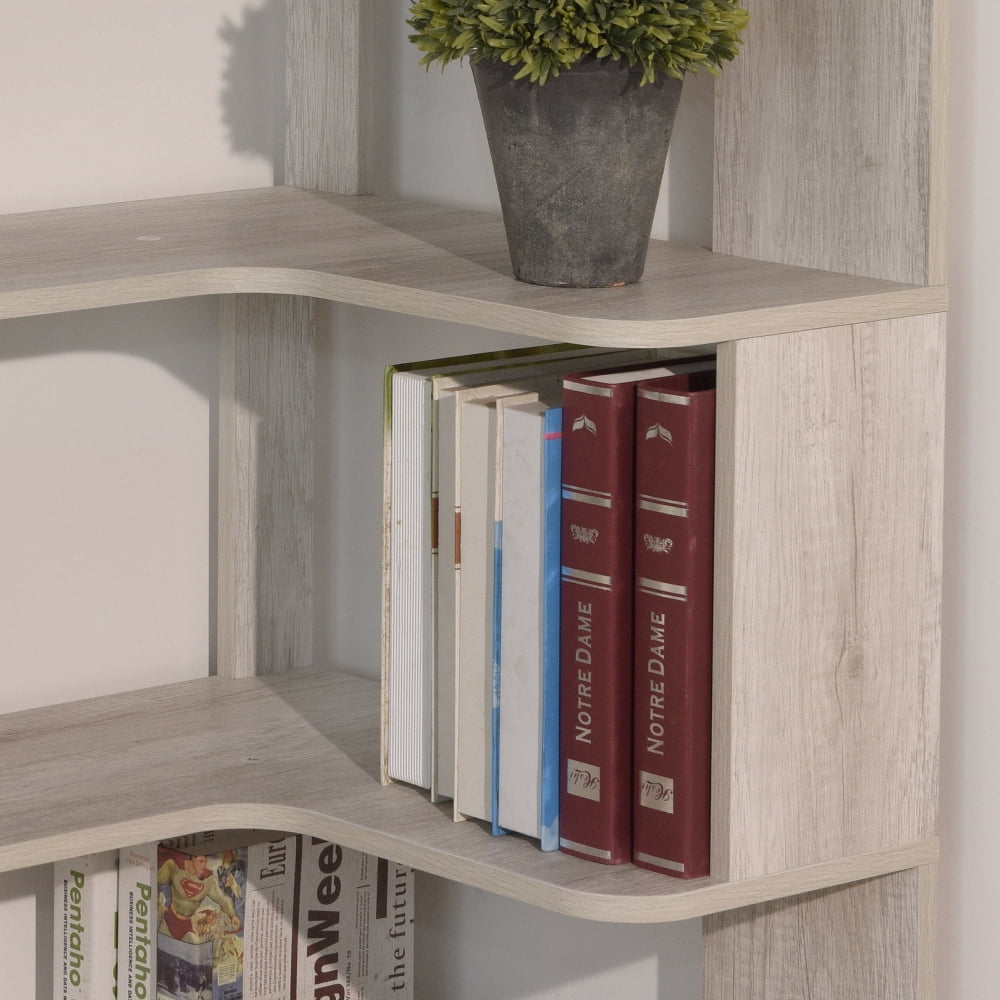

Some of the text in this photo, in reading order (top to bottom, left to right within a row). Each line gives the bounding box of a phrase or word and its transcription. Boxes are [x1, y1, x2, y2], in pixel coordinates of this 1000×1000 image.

[575, 601, 593, 745] NOTRE DAME
[647, 611, 666, 757] NOTRE DAME
[69, 868, 85, 988] Pentaho
[134, 881, 153, 1000] Pentaho
[388, 863, 407, 992] the futur
